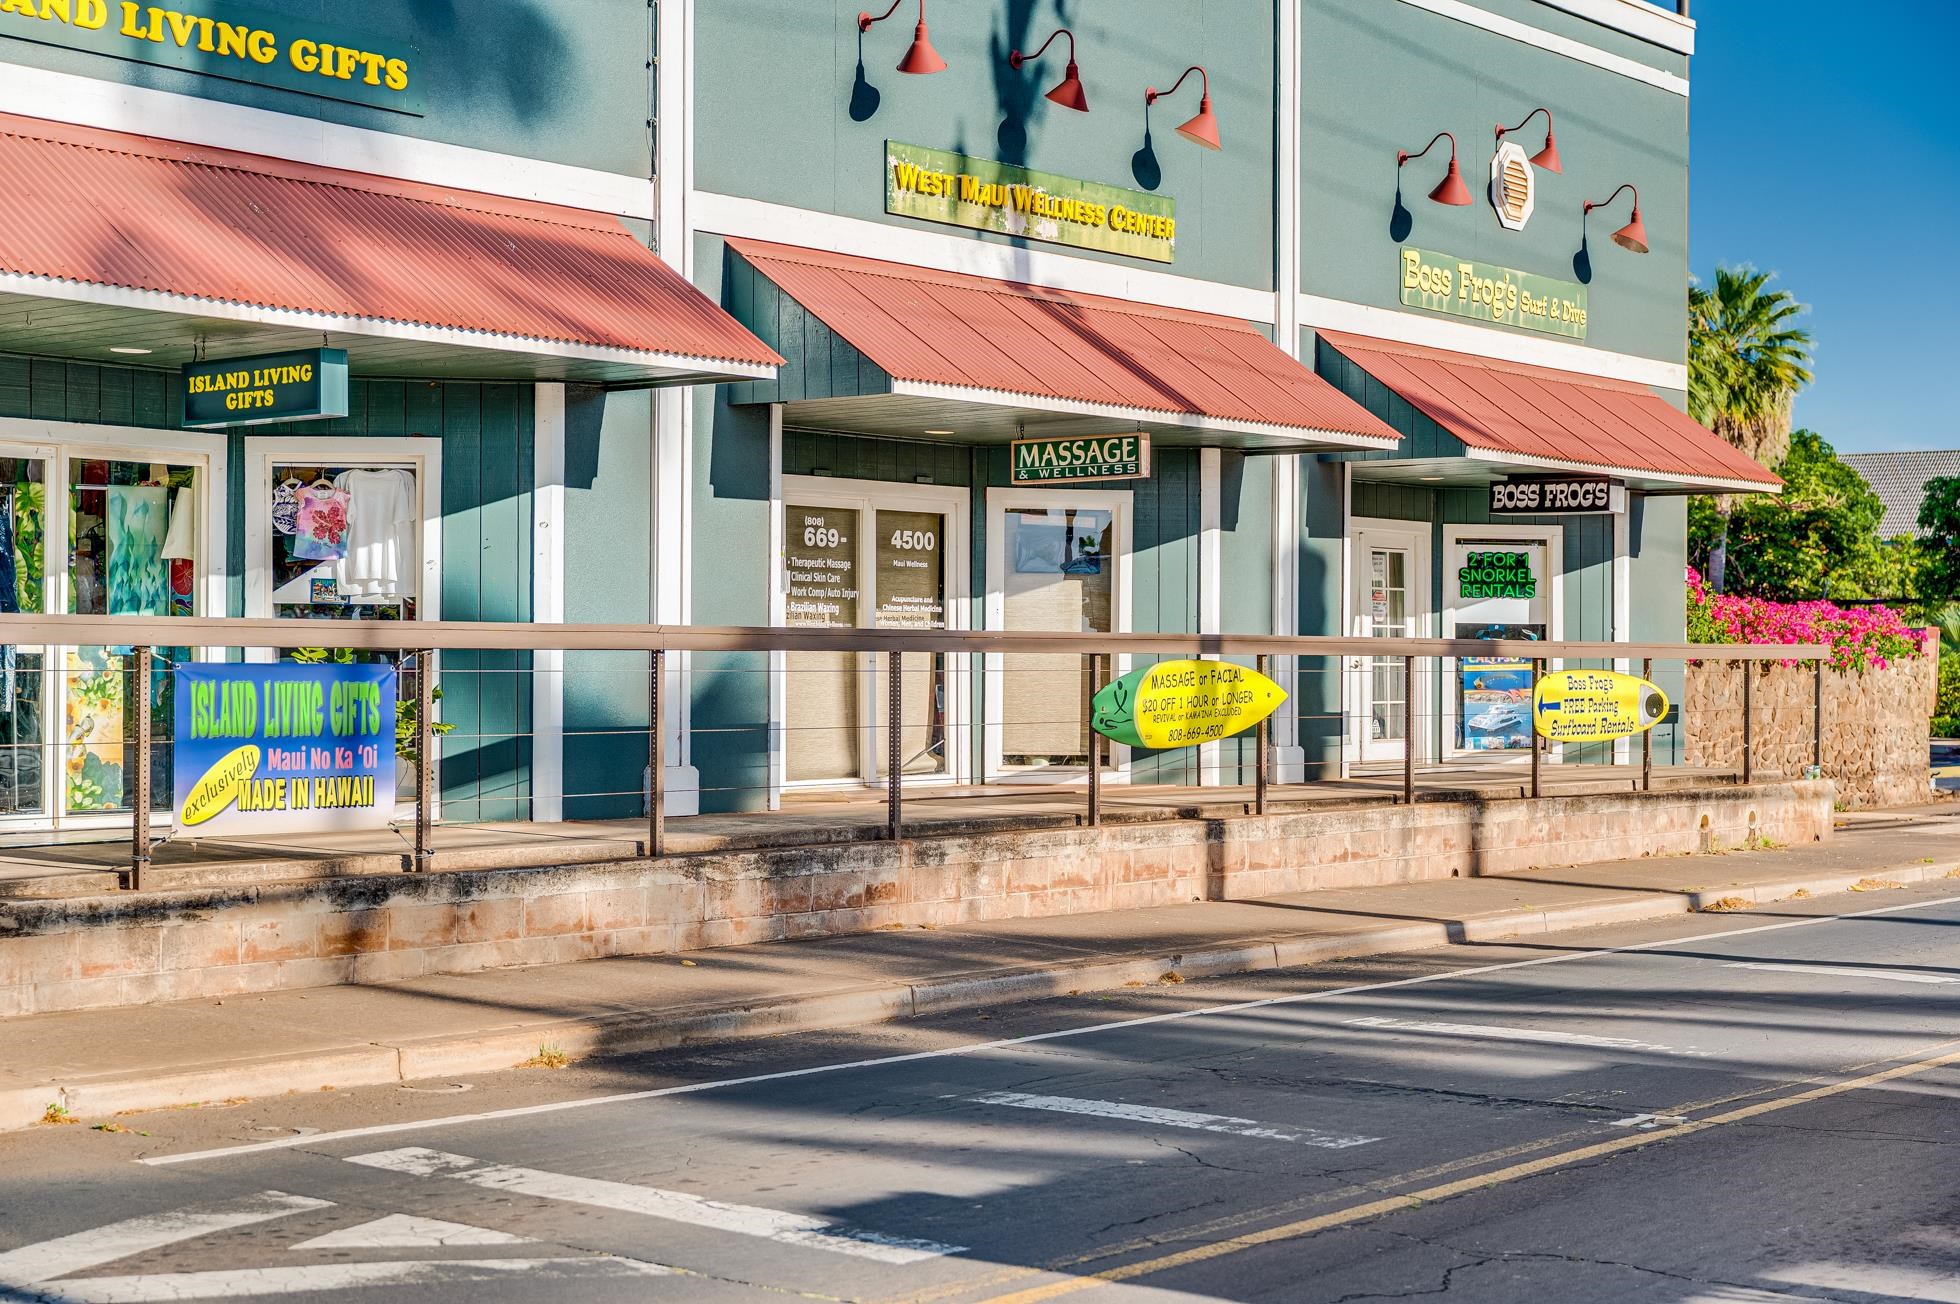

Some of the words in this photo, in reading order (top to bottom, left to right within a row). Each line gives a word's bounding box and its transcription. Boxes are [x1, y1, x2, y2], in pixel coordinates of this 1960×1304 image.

[120, 2, 277, 63] LIVING
[289, 39, 408, 90] GIFTS
[896, 162, 953, 196] WEST
[960, 175, 1008, 206] MAUI
[1013, 184, 1106, 225] WELLNESS
[1110, 204, 1175, 238] CENTER
[1403, 250, 1452, 296] Boss
[1457, 263, 1517, 319] Frog's
[1520, 291, 1547, 318] Surf
[1550, 297, 1560, 319] &
[1562, 300, 1586, 326] Dive
[189, 370, 250, 393] ISLAND
[253, 364, 312, 387] LIVING
[226, 389, 274, 410] GIFTS
[1020, 438, 1136, 468] MASSAGE
[1019, 470, 1028, 479] &
[1039, 464, 1136, 478] WELLNESS
[1493, 484, 1540, 509] BOSS
[1544, 482, 1608, 508] FROG'S
[804, 515, 824, 527] (808)
[890, 530, 935, 551] 4500
[791, 557, 826, 569] Therapeutic
[827, 558, 851, 571] Massage
[1468, 553, 1477, 567] 2
[1484, 553, 1516, 567] FOR
[1522, 553, 1529, 567] 1
[791, 571, 812, 581] Clinical
[814, 572, 826, 582] Skin
[827, 573, 840, 583] Care
[1460, 568, 1537, 582] SNORKEL
[791, 586, 807, 596] Work
[842, 588, 860, 600] Injury
[1461, 584, 1535, 598] RENTALS
[790, 601, 816, 612] Brazilian
[817, 602, 840, 615] Waxing
[1152, 671, 1195, 690] MASSAGE
[1199, 675, 1208, 686] or
[1211, 668, 1244, 686] FACIAL
[1567, 675, 1586, 690] Boss
[190, 679, 257, 740] ISLAND
[264, 680, 325, 738] LIVING
[330, 680, 381, 736] GIFTS
[1142, 699, 1157, 714] $20
[1161, 697, 1176, 711] OFF
[1179, 698, 1183, 709] 1
[1186, 694, 1209, 709] HOUR
[1212, 696, 1220, 706] or
[1222, 690, 1254, 706] LONGER
[1564, 698, 1585, 714] FREE
[1588, 697, 1619, 717] Parking
[1153, 713, 1176, 723] REVIVAL
[1214, 707, 1242, 718] EXCLUDED
[1168, 724, 1224, 742] 808-669-4500
[1551, 718, 1596, 736] Surfboard
[1600, 716, 1635, 734] Rentals
[267, 746, 306, 771] Maui
[311, 748, 330, 769] No
[335, 748, 353, 768] Ka
[184, 751, 255, 820] exclusively
[237, 777, 286, 812] MADE
[291, 776, 309, 810] IN
[315, 775, 374, 808] HAWAII
